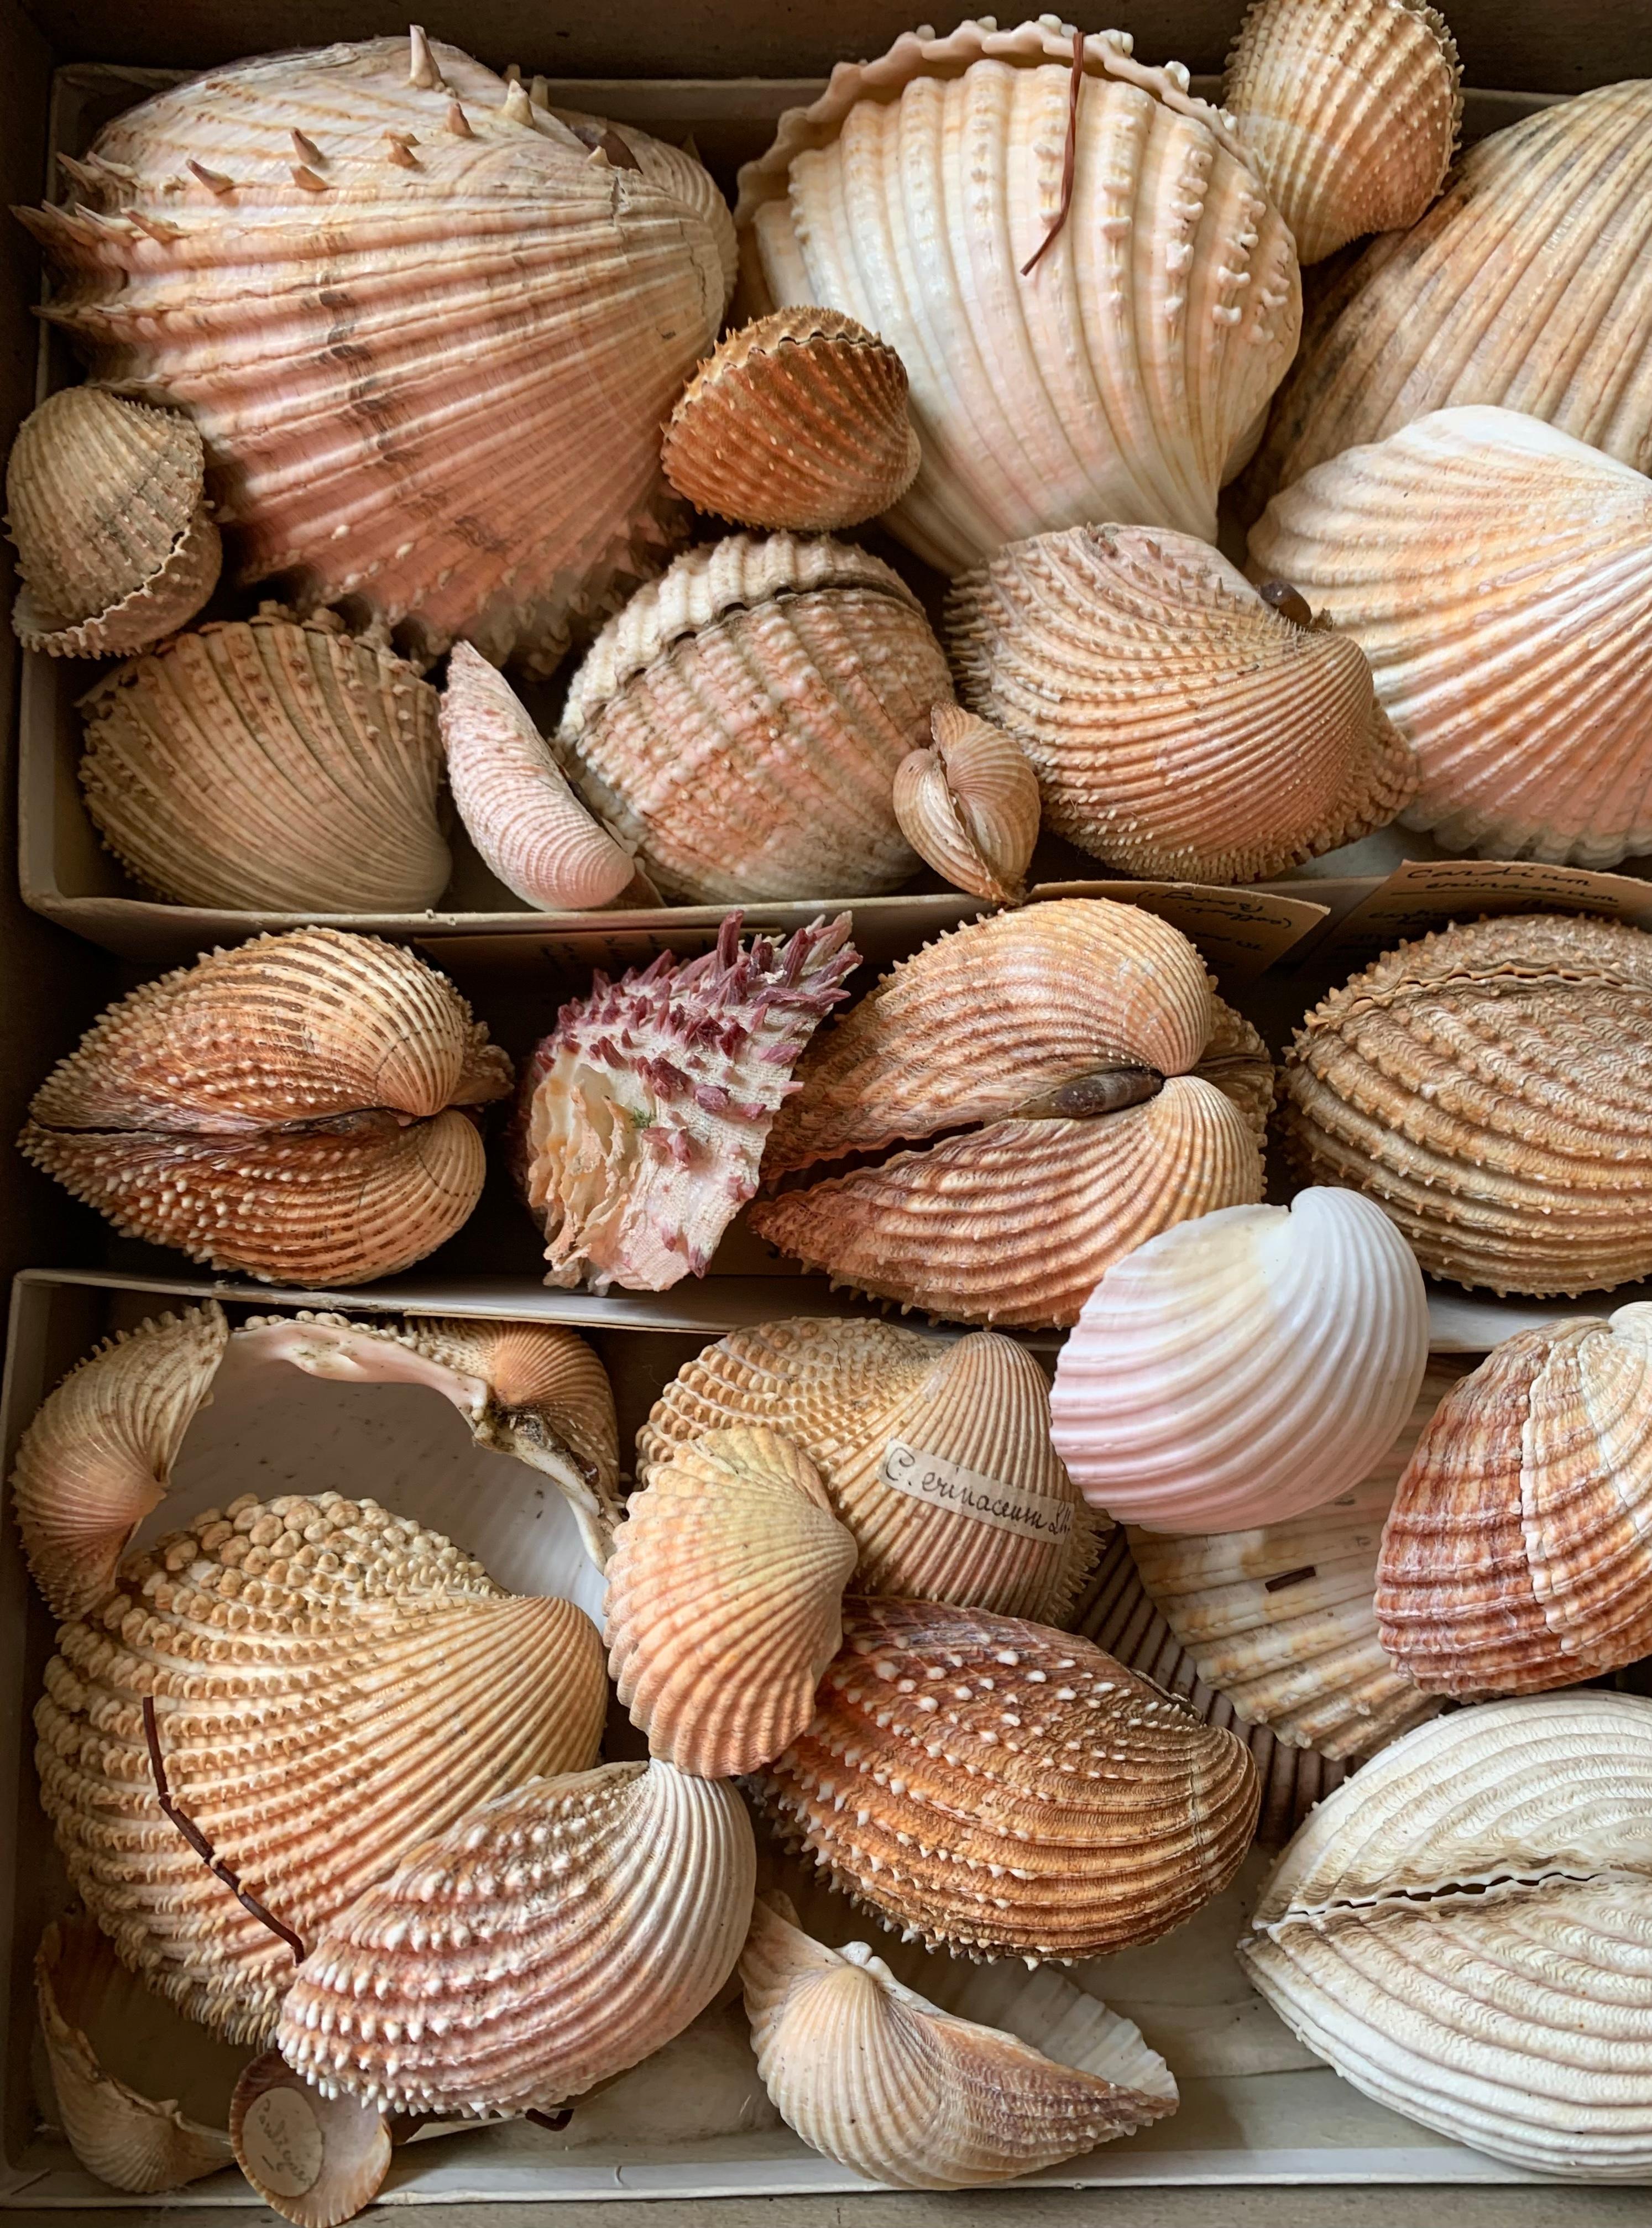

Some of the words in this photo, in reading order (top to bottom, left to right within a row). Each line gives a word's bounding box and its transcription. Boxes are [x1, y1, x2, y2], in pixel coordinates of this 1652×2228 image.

[1407, 866, 1591, 887] Cardium
[886, 1446, 916, 1487] C.
[922, 1466, 1047, 1530] erinaceum
